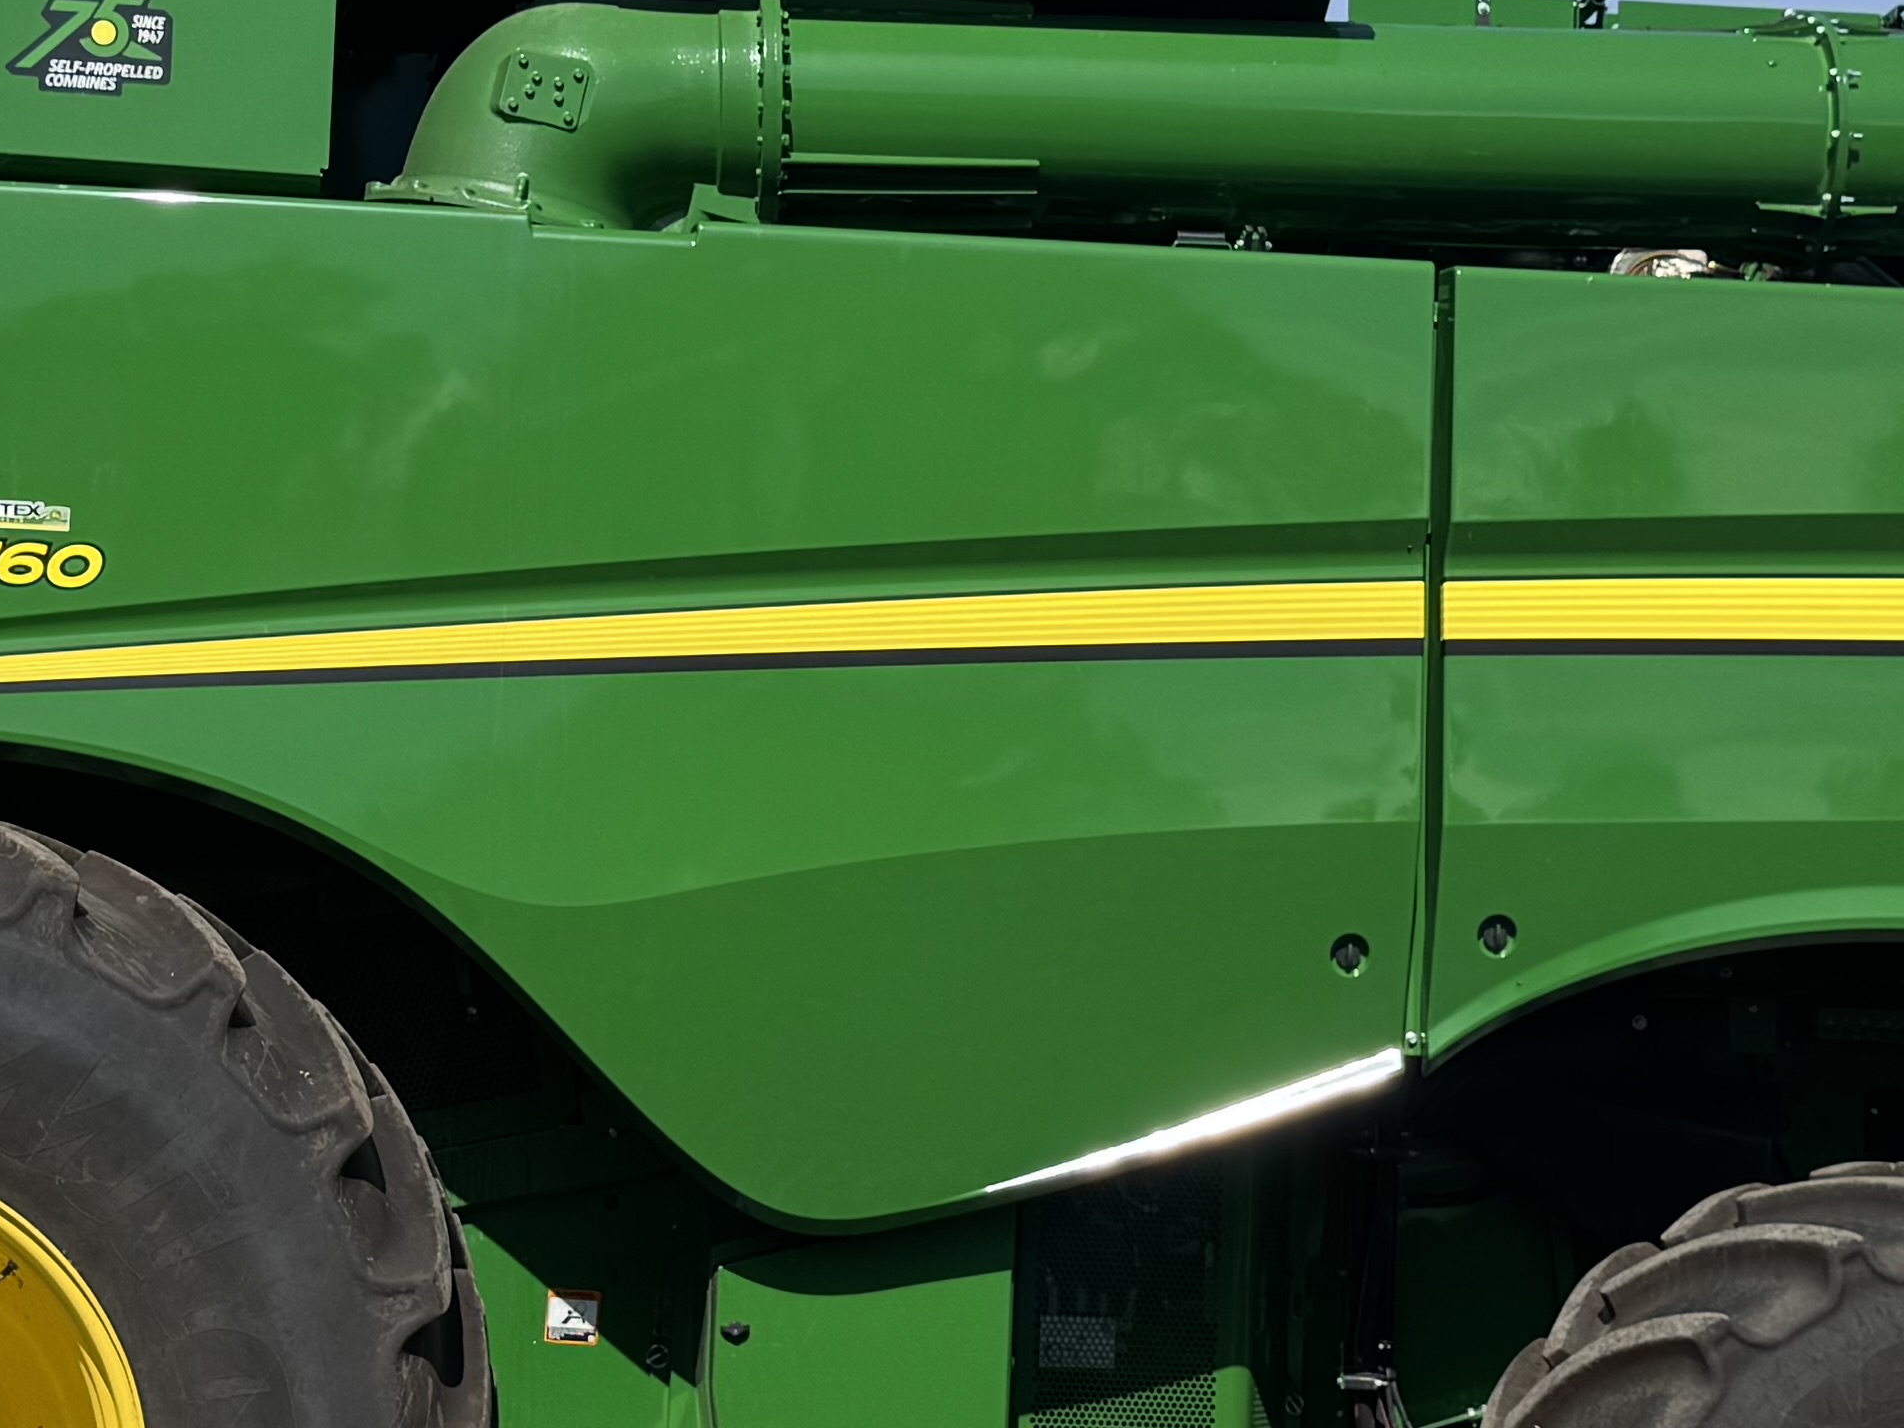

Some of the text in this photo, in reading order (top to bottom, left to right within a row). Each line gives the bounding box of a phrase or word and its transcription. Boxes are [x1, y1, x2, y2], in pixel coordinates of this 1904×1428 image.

[132, 14, 166, 30] SINCE
[138, 30, 164, 44] 1947
[49, 59, 163, 80] SELF-PROPELLED
[46, 73, 117, 91] COMBINES
